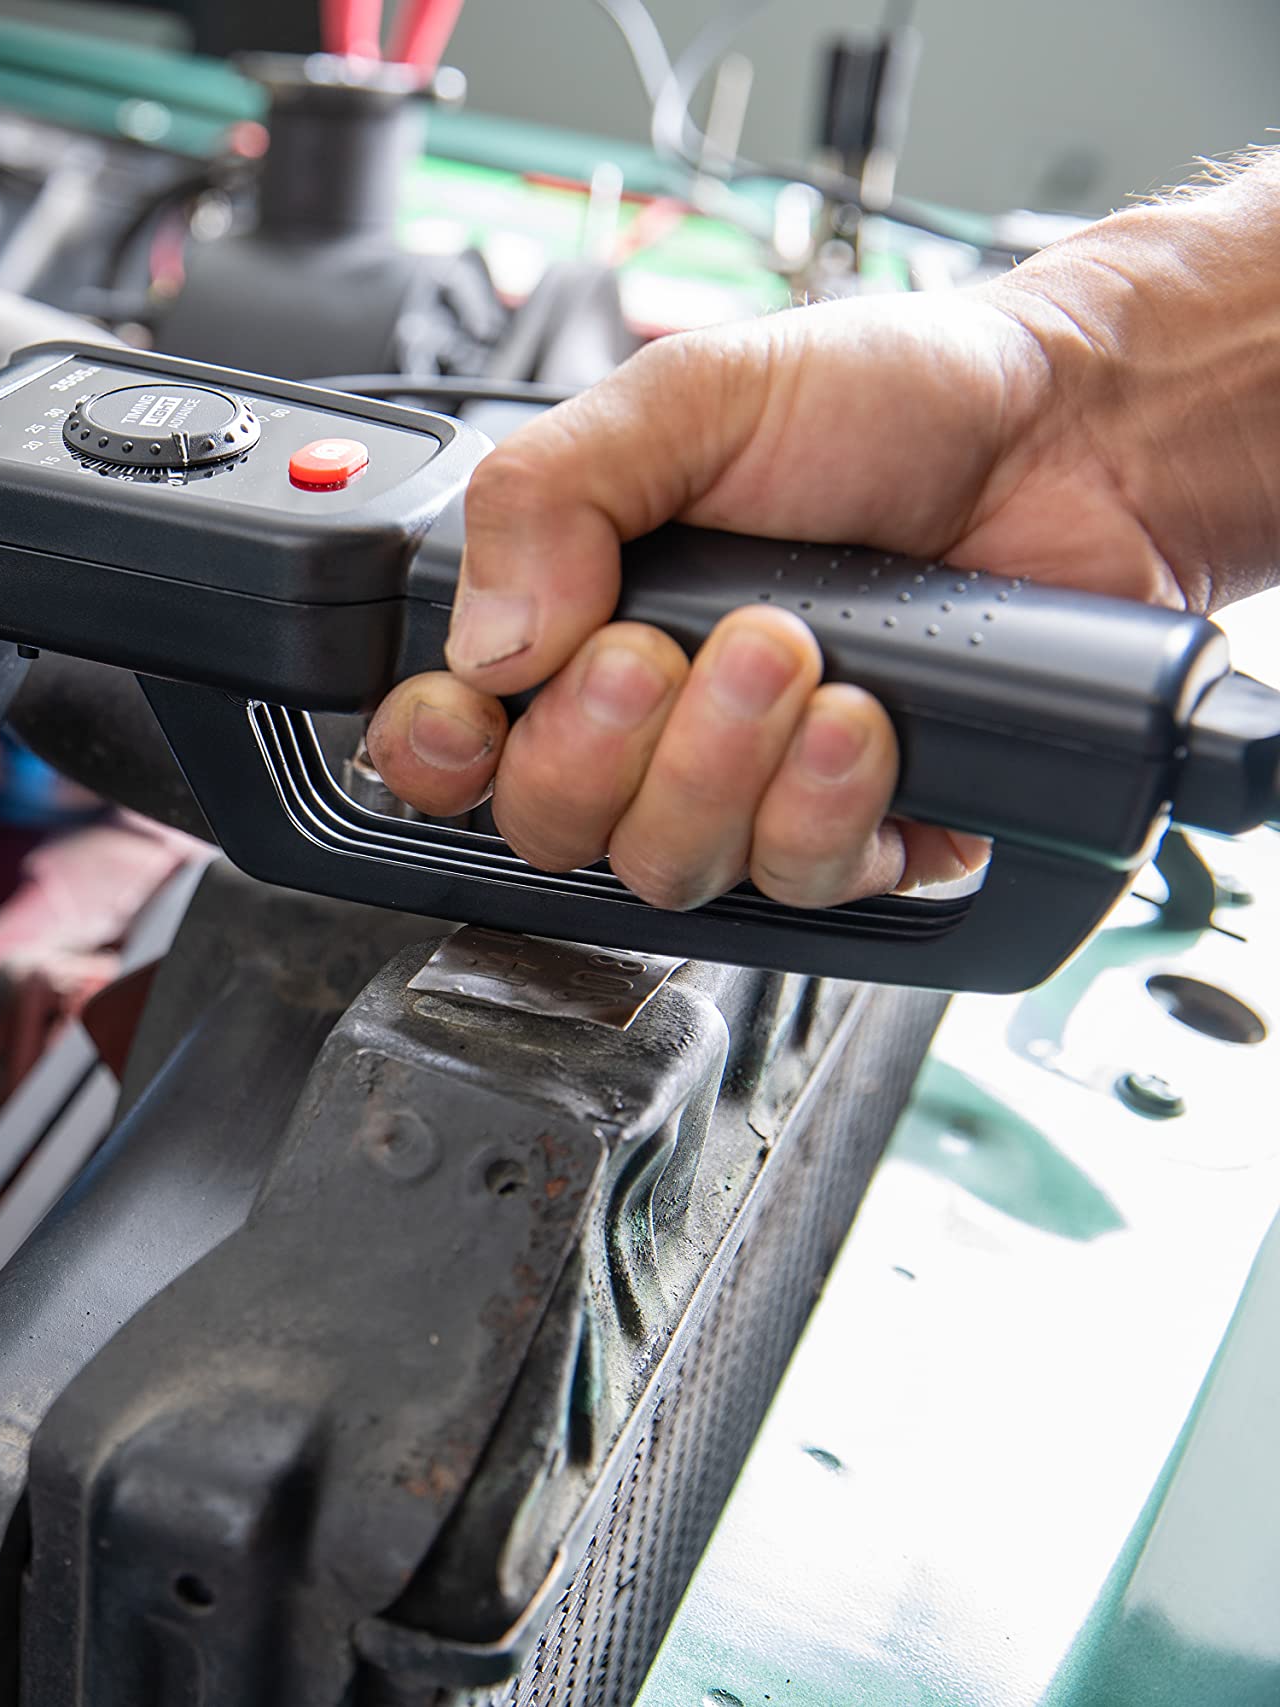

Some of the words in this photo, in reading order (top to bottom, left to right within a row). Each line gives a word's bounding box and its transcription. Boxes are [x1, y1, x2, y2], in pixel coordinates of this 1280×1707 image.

[44, 407, 66, 418] 30
[120, 394, 157, 424] TIMING
[145, 398, 177, 425] LIGHT
[167, 398, 201, 429] ADVANCE
[270, 408, 291, 418] 60
[25, 423, 46, 434] 25
[23, 440, 44, 451] 20
[40, 456, 61, 465] 15
